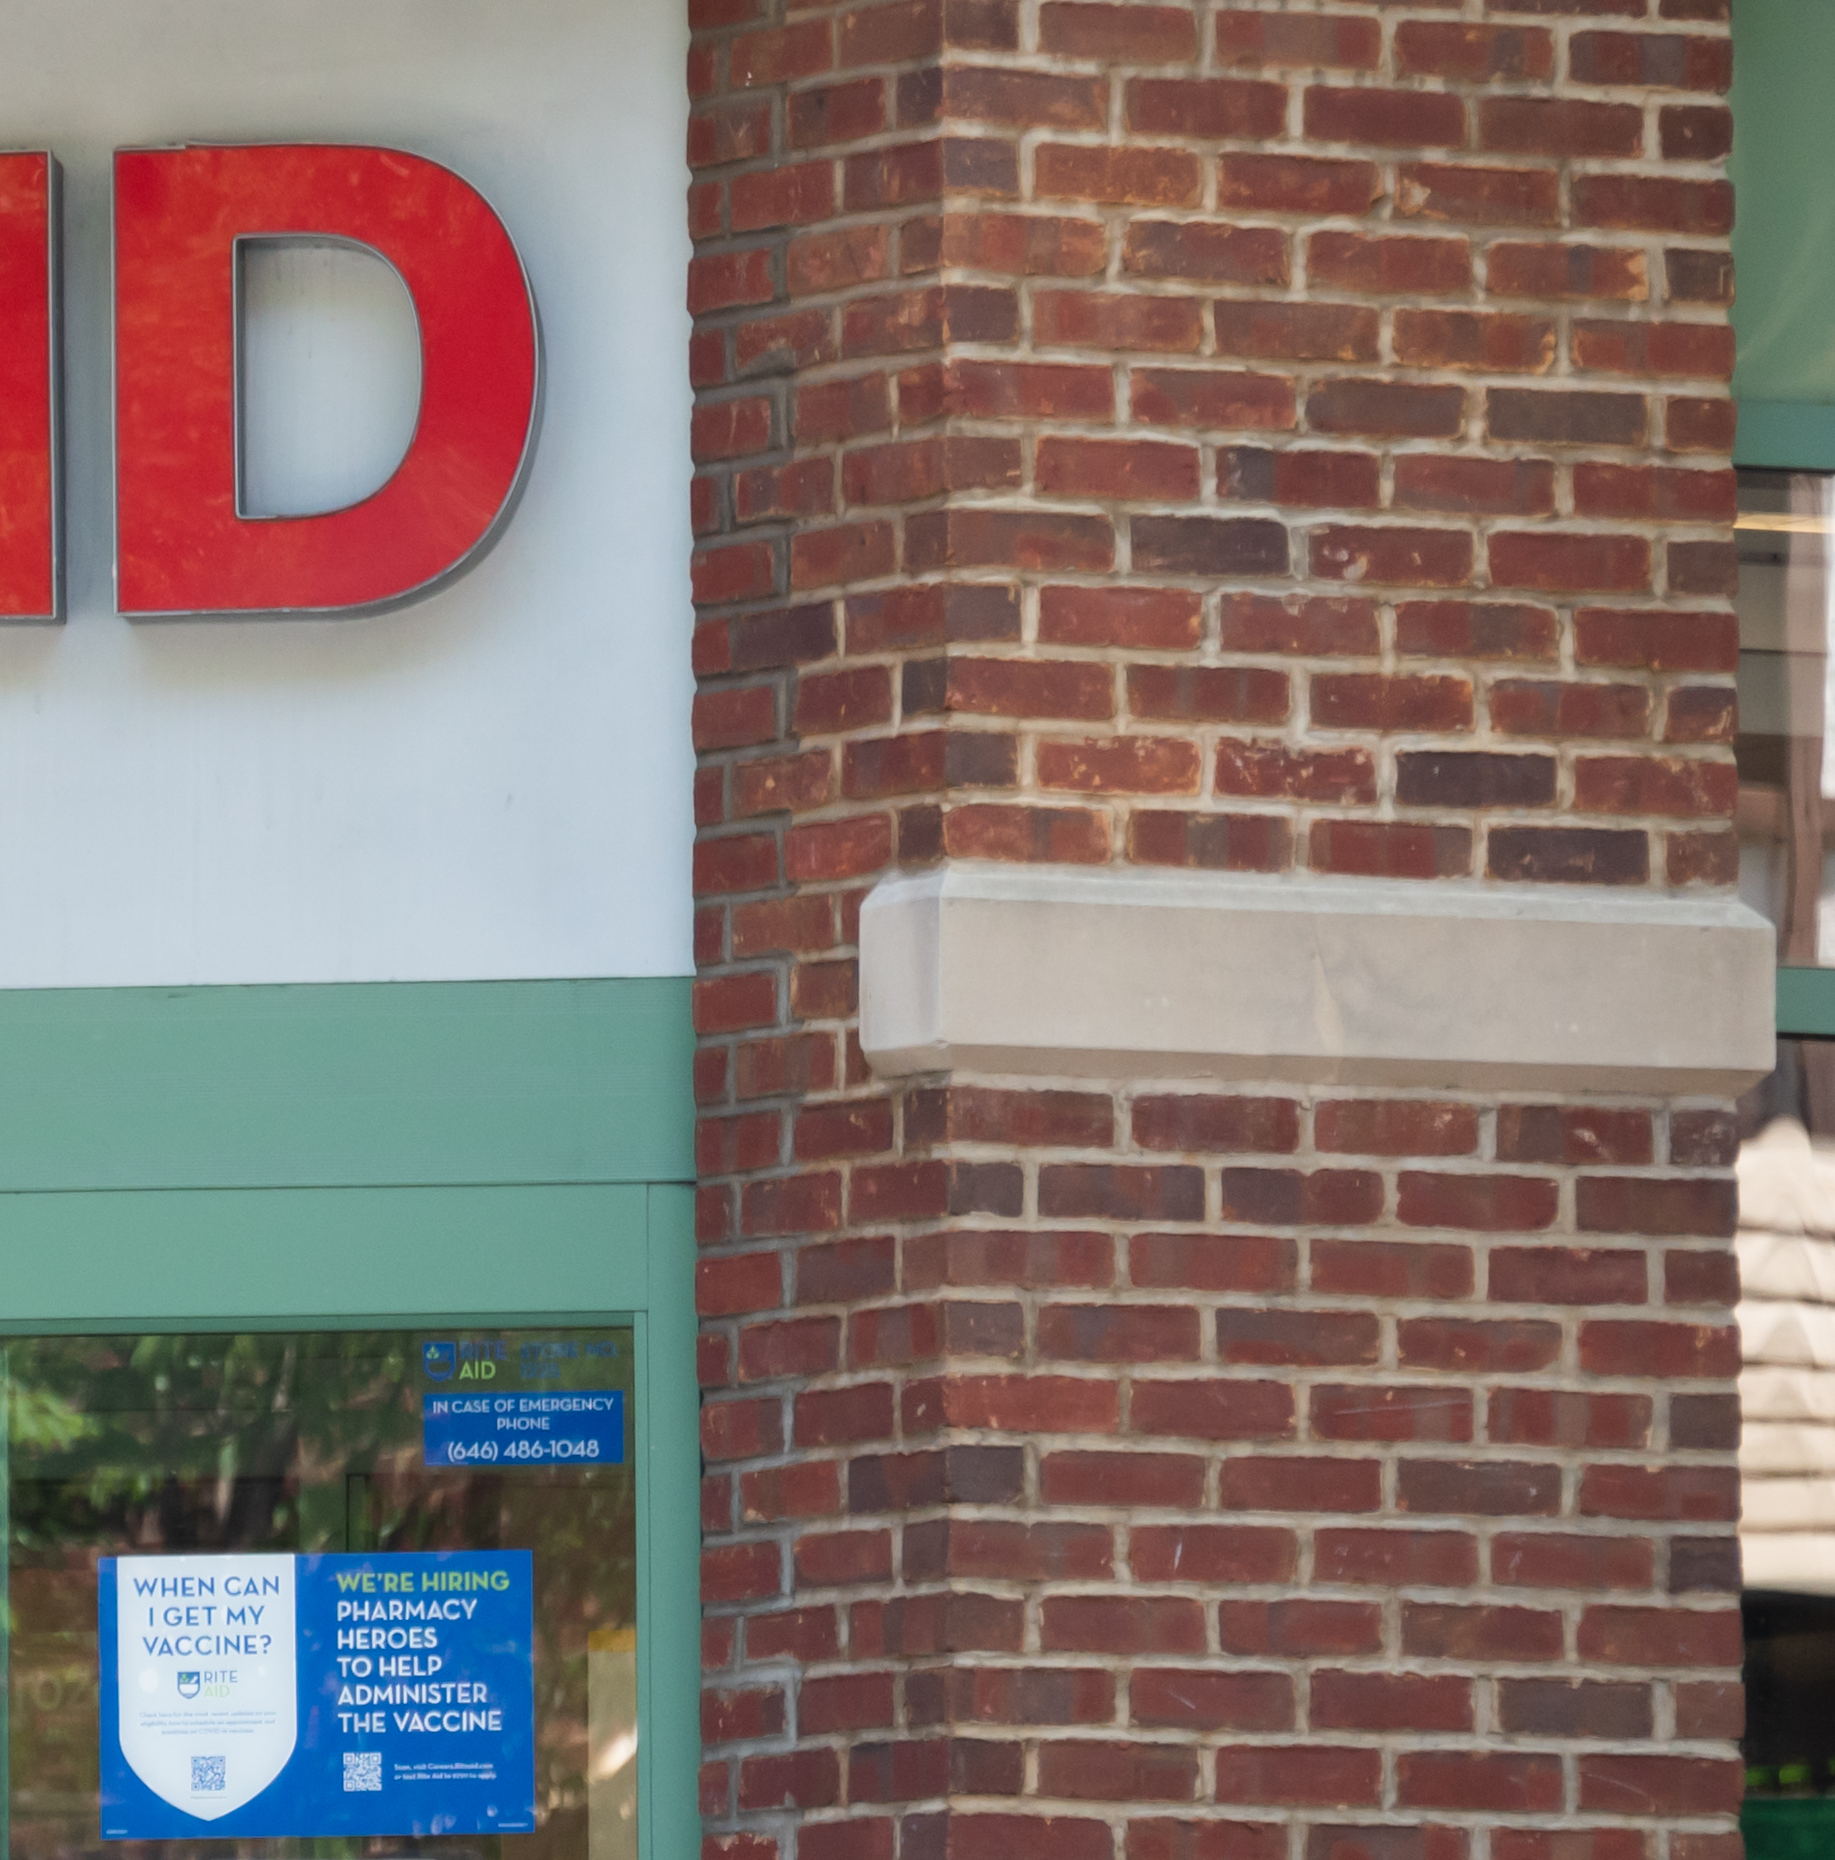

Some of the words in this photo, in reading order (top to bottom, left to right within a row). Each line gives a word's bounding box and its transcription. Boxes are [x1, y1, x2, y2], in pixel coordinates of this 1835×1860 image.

[460, 1342, 507, 1360] RITE
[459, 1361, 496, 1380] AID
[433, 1401, 449, 1414] IN
[451, 1400, 490, 1413] CASE
[494, 1400, 516, 1412] OF
[519, 1398, 614, 1411] EMERGENCY
[496, 1416, 551, 1431] PHONE
[447, 1441, 499, 1463] (646)
[503, 1440, 600, 1459] 486-1048
[133, 1576, 215, 1597] WHEN
[223, 1576, 280, 1596] CAN
[336, 1572, 415, 1593] WE'RE
[421, 1570, 510, 1592] HIRING
[148, 1606, 154, 1627] I
[162, 1606, 217, 1627] GET
[226, 1605, 265, 1626] MY
[337, 1598, 478, 1622] PHARMACY
[142, 1634, 273, 1657] VACCINE?
[337, 1627, 439, 1650] HEROES
[203, 1670, 238, 1683] RITE
[337, 1656, 372, 1678] TO
[378, 1655, 443, 1677] HELP
[203, 1685, 230, 1698] AID
[337, 1682, 488, 1706] ADMINISTER
[337, 1711, 386, 1733] THE
[392, 1710, 503, 1733] VACCINE
